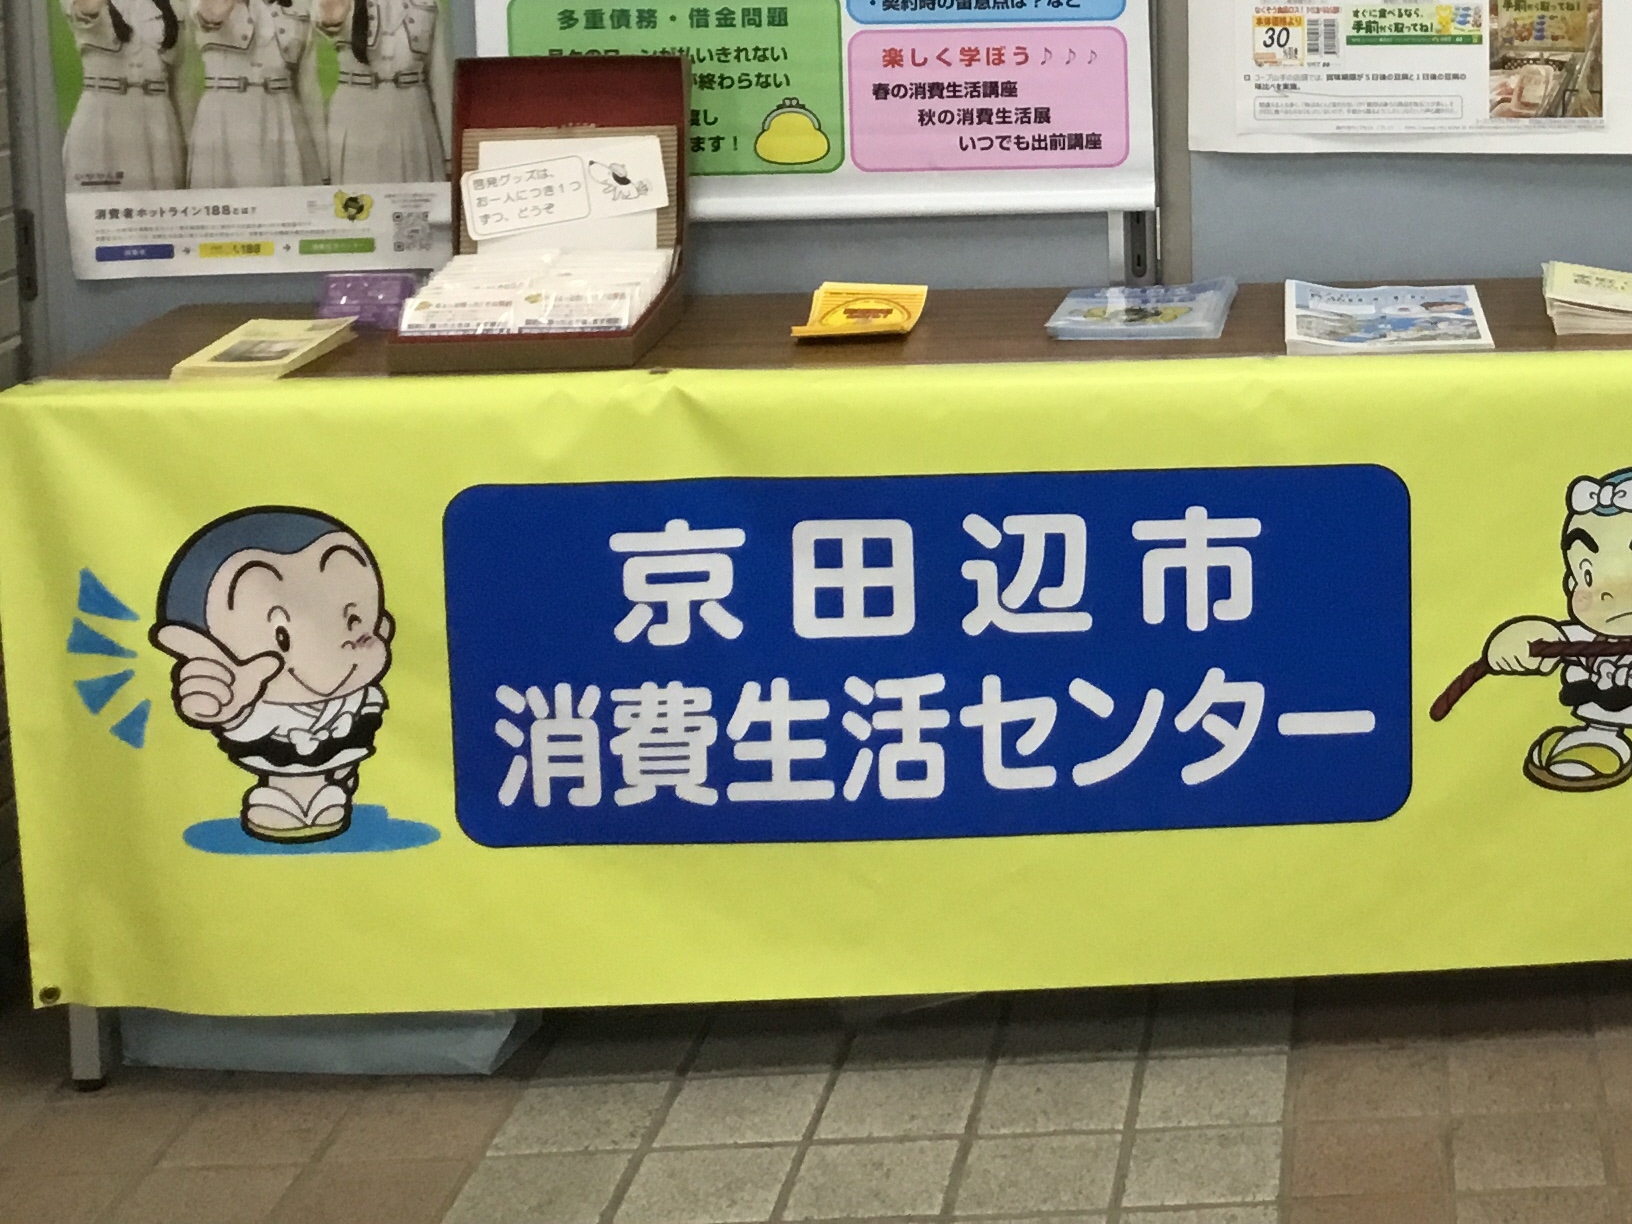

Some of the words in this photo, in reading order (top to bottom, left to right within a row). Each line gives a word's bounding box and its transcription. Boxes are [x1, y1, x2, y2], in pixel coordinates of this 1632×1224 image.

[557, 7, 789, 30] 多重債務・借金問題
[1263, 27, 1290, 48] 30
[872, 81, 1018, 100] 春の消費生活講座
[918, 106, 1051, 126] 秋の消費生活展
[958, 132, 1103, 152] いつでも出前講座
[608, 503, 1262, 646] 京田辺市
[494, 668, 1377, 809] 消費生活センター
